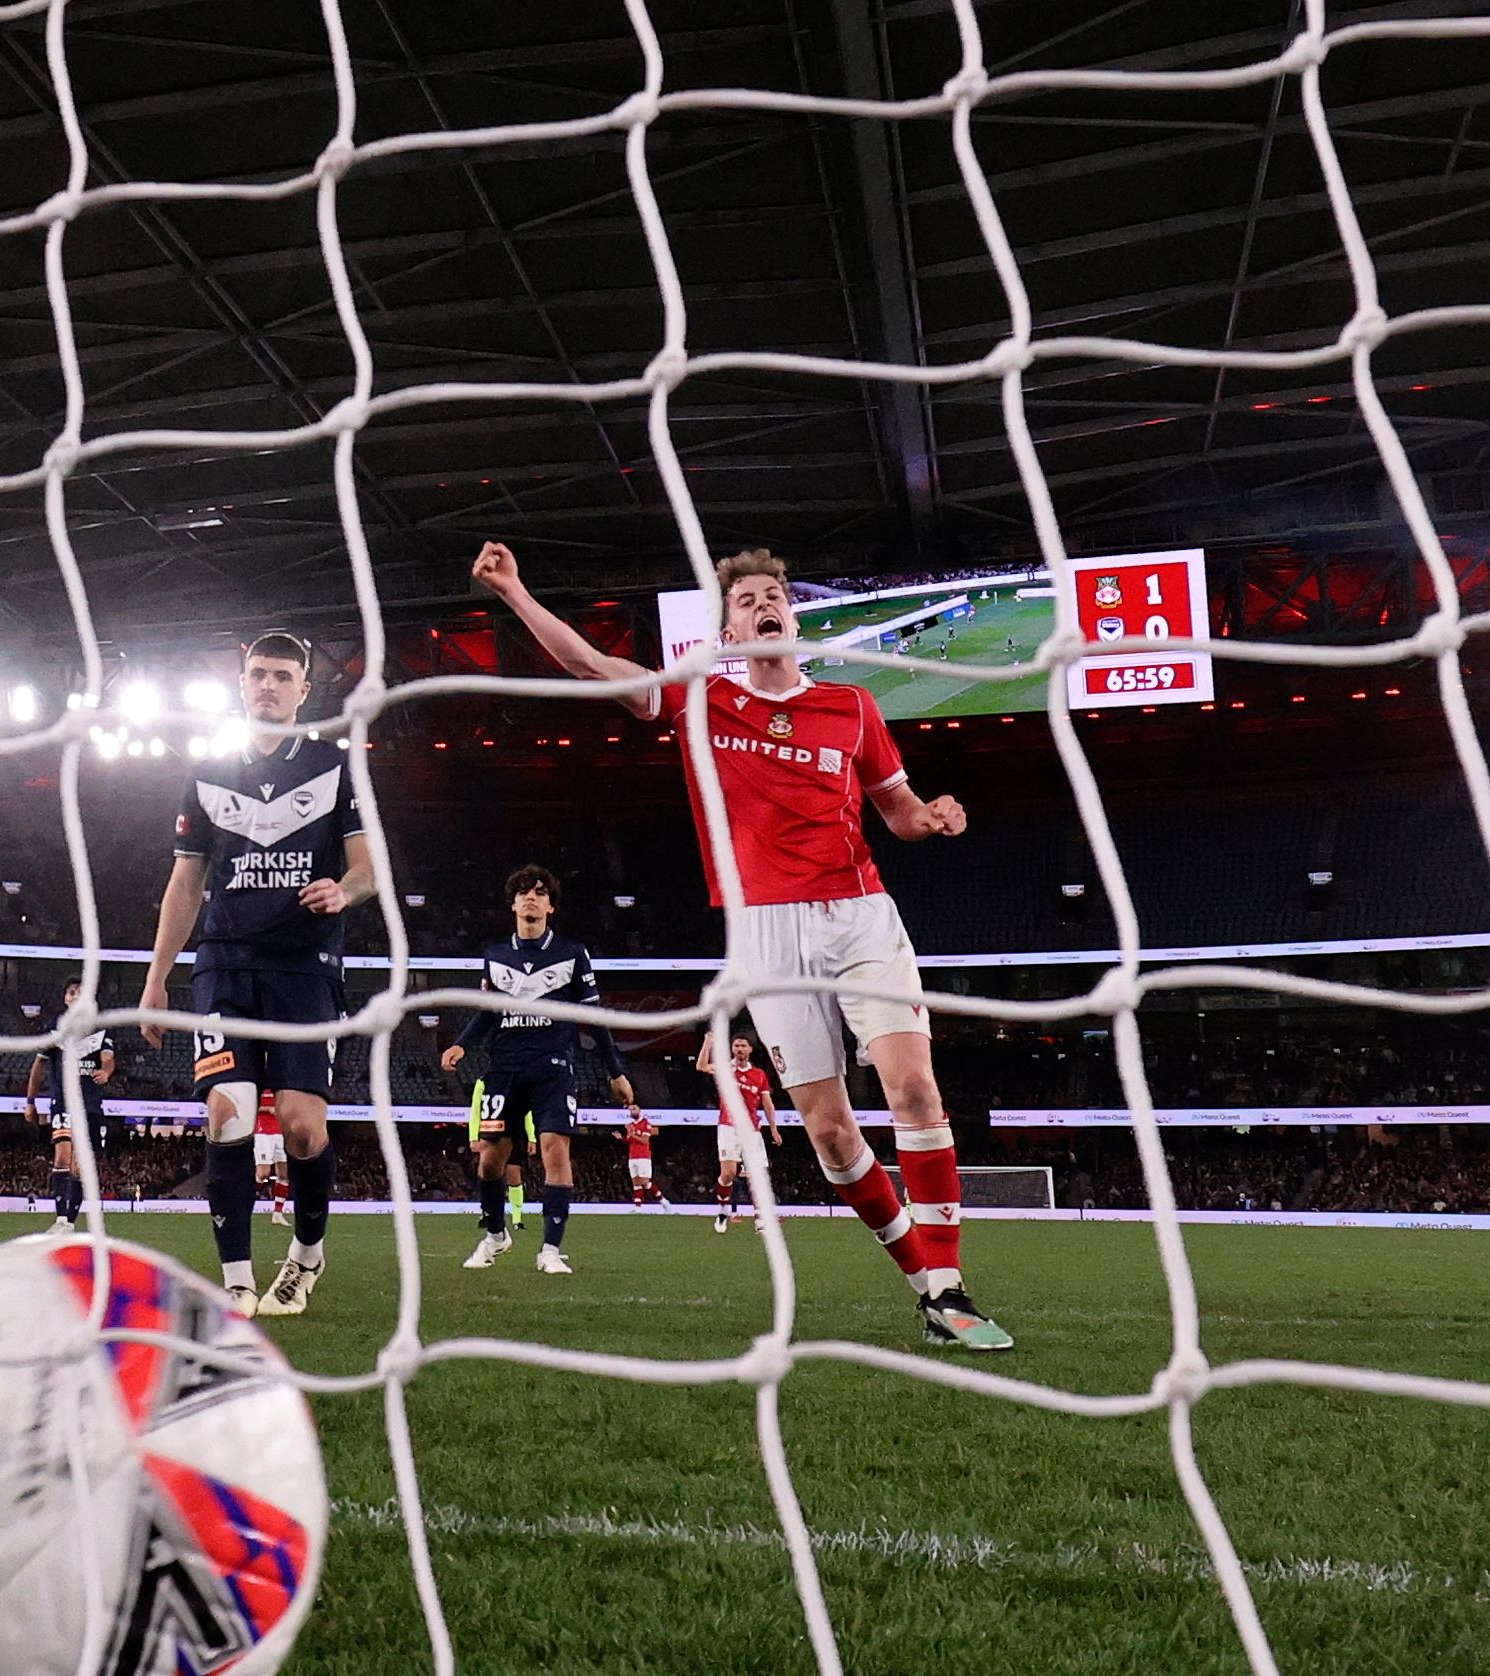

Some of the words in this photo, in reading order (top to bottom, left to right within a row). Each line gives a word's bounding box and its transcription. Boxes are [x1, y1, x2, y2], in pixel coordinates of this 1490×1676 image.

[1146, 573, 1163, 605] 1
[1145, 615, 1169, 642] 0
[1106, 666, 1176, 692] 65:59
[713, 734, 813, 763] UNITED
[230, 851, 313, 875] TURKISH
[225, 870, 312, 890] AIRLINES
[480, 1094, 506, 1120] 39
